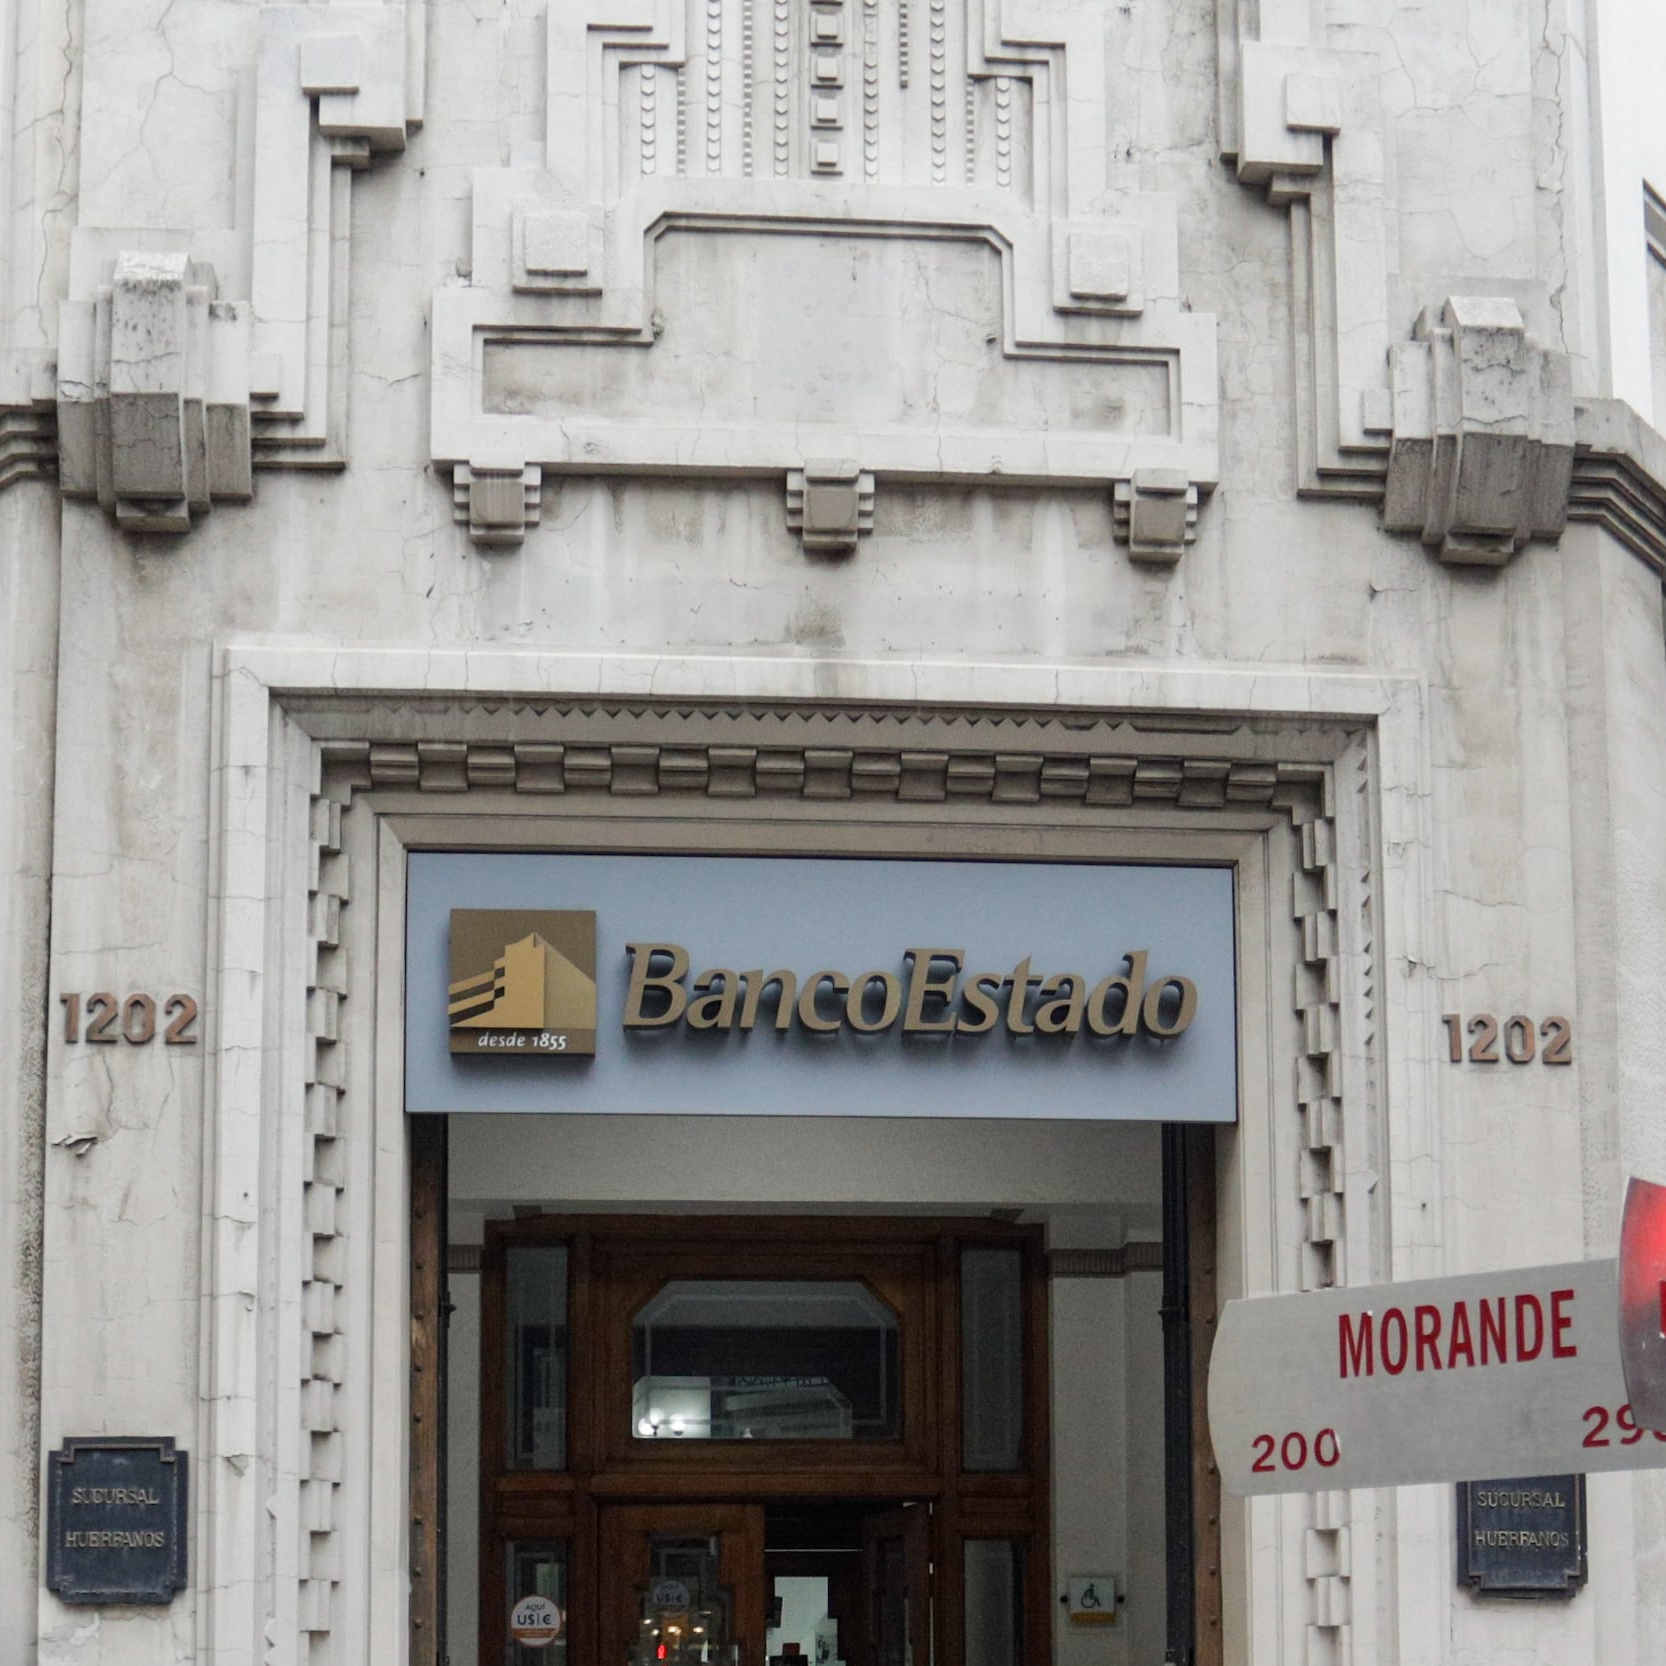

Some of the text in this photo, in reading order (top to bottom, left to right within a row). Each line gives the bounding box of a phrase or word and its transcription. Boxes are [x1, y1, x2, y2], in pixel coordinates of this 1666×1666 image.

[621, 942, 1198, 1038] BancoEstado
[59, 992, 198, 1044] 1202
[478, 1031, 568, 1050] desde 1855
[1442, 1012, 1573, 1065] 1202
[1338, 1289, 1578, 1379] MORANDE
[1251, 1428, 1341, 1473] 200
[71, 1487, 160, 1505] SUCURSAL
[1477, 1491, 1566, 1508] SUCURSAL
[64, 1531, 165, 1548] HUERFANOS
[1473, 1530, 1570, 1548] HUERFANOS
